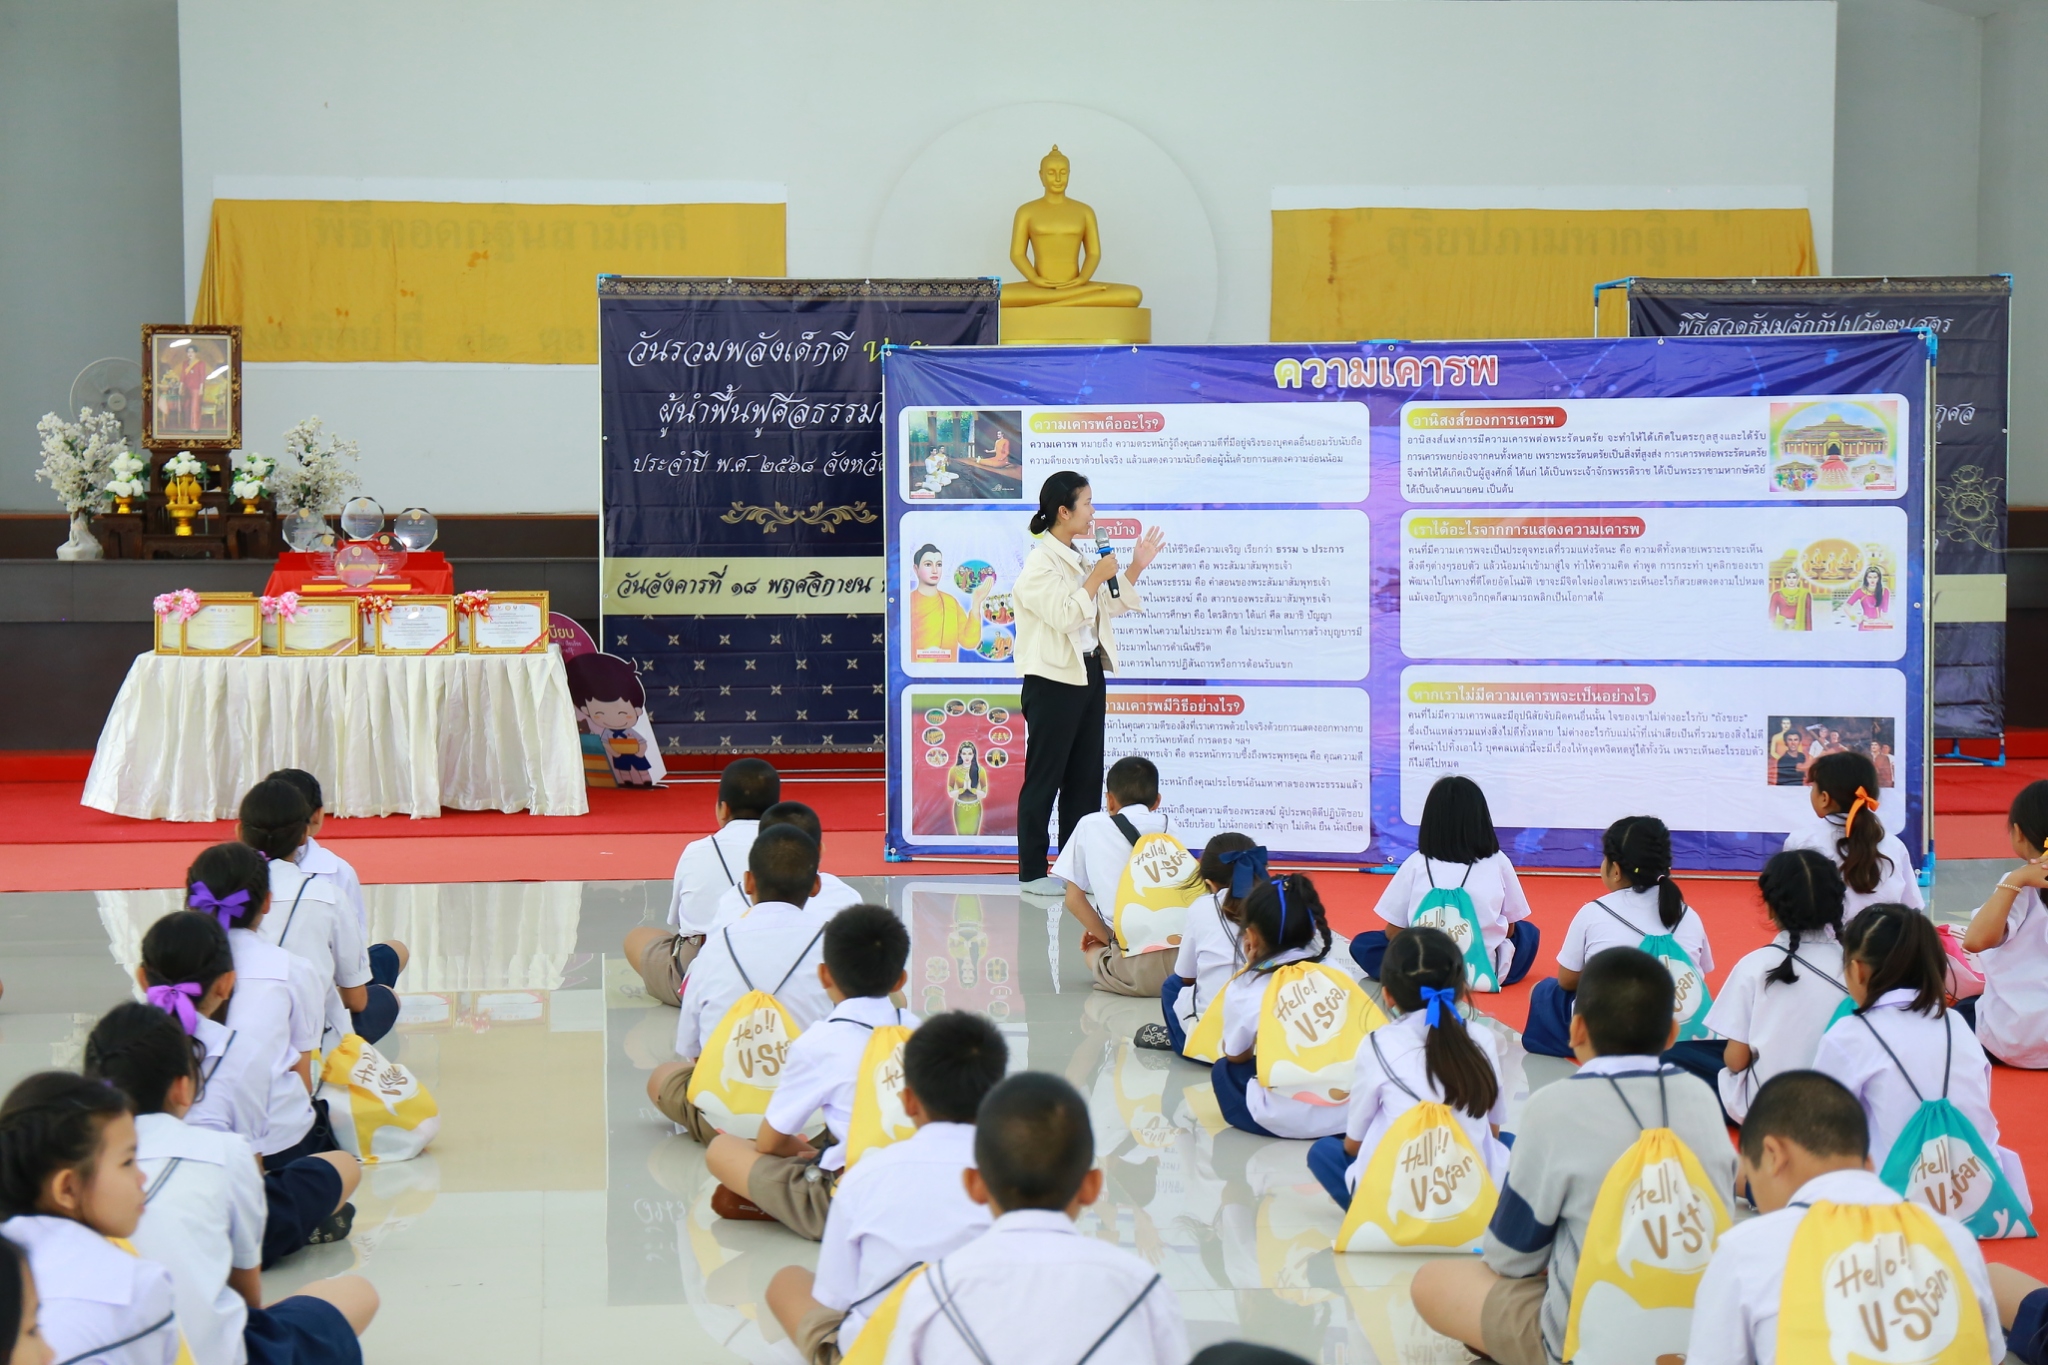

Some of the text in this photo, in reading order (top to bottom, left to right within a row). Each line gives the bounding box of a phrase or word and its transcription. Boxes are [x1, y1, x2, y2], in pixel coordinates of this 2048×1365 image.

[628, 330, 856, 368] วันรวมพลังเด็กดี
[1274, 354, 1499, 388] ความเคารพ
[1034, 413, 1160, 430] ความเคารพคืออะไร?
[1413, 410, 1555, 427] อานิสงส์ของการเคารพ
[1030, 441, 1078, 450] ความเคารพ
[1081, 438, 1112, 449] หมายถึง
[1407, 430, 1767, 444] อานิสงส์แห่งการมีความเคารพต่อพระรัตนตรัย จะทำให้ได้เกิดในตระกูลสูงและได้รับ
[1030, 454, 1123, 465] ความดีของเขาด้วยใจจริง
[1407, 446, 1767, 461] การเคารพยกย่องจากคนทั้งหลาย เพราะพระรัตนตรัยเป็นสิ่งที่สูงส่ง การเคารพต่อพระรัตนตรัย
[633, 450, 713, 477] ประจำปี
[716, 453, 759, 474] พ.ศ.
[760, 454, 818, 475] ๒๕๖๘
[1407, 464, 1766, 480] จึงทำให้ได้เกิดเป็นผู้สูงศักดิ์ ได้แก่ ได้เป็นพระเจ้าจักรพรรดิราช ได้เป็นพระราชามหากษัตริย์
[1407, 483, 1514, 494] ได้เป็นเจ้าคนนายคน เป็นต้น
[1413, 519, 1640, 536] เราได้อะไรจากการแสดงความเคารพ
[1244, 543, 1273, 554] เรียกว่า
[1276, 545, 1299, 554] ธรรม
[1312, 545, 1344, 554] ประการ
[1620, 544, 1631, 554] คือ
[1634, 541, 1763, 554] ความดีทั้งหลายเพราะเขาจะเห็น
[1199, 560, 1210, 570] คือ
[1213, 560, 1292, 572] พระสัมมาสัมพุทธเจ้า
[1408, 558, 1764, 573] สิ่งดีๆต่างๆรอบตัว แล้วน้อมนำเข้ามาสู่ใจ ทำให้ความคิด คำพูด การกระทำ บุคลิกของเขา
[617, 565, 728, 598] วันอังคารที่
[731, 581, 760, 597] ๑๘
[767, 571, 874, 598] พฤศจิกายน
[1195, 576, 1206, 586] คือ
[1209, 576, 1331, 589] คำสอนของพระสัมมาสัมพุทธเจ้า
[1408, 573, 1765, 587] พัฒนาไปในทางที่ดีโดยอัตโนมัติ เขาจะมีจิตใจผ่องใสเพราะเห็นอะไรก็สวยสดงดงามไปหมด
[1196, 593, 1207, 603] คือ
[1211, 593, 1331, 605] สาวกของพระสัมมาสัมพุทธเจ้า
[1194, 609, 1205, 619] คือ
[1246, 609, 1266, 620] ได้แก่
[1269, 610, 1281, 620] ศีล
[1284, 610, 1304, 620] สมาธิ
[1307, 610, 1332, 622] ปัญญา
[1226, 625, 1237, 635] คือ
[1240, 625, 1362, 638] ไม่ประมาทในการสร้างบุญบารมี
[1116, 641, 1211, 652] ประมาทในการดำเนินชีวิต
[1413, 685, 1650, 703] หากเราไม่มีความเคารพจะเป็นอย่างไร
[1105, 697, 1240, 712] วามเคารพมีวิธีอย่างไร?
[1408, 707, 1605, 722] คนที่ไม่มีความเคารพและมีอุปนิสัยจับผิดคนอื่นนั้น
[1608, 710, 1708, 723] ใจของเขาไม่ต่างอะไรกับ
[1408, 722, 1554, 737] ซึ่งเป็นแหล่งรวมแห่งสิ่งไม่ดีทั้งหลาย
[1108, 732, 1250, 745] การไหว้ การวันทยหัตถ์ การลดธง ฯลฯ
[1408, 739, 1482, 752] ที่คนนำไปทิ้งเอาไว้
[1674, 744, 1763, 756] เพราะเห็นอะไรรอบตัว
[1175, 748, 1186, 758] คือ
[1310, 750, 1321, 760] คือ
[1323, 751, 1363, 763] คุณความดี
[1408, 756, 1459, 768] ก็ไม่ดีไปหมด
[1292, 819, 1316, 831] ไม่เดิน
[1411, 1156, 1473, 1212] V-Star
[1858, 1267, 1949, 1353] V-Star
